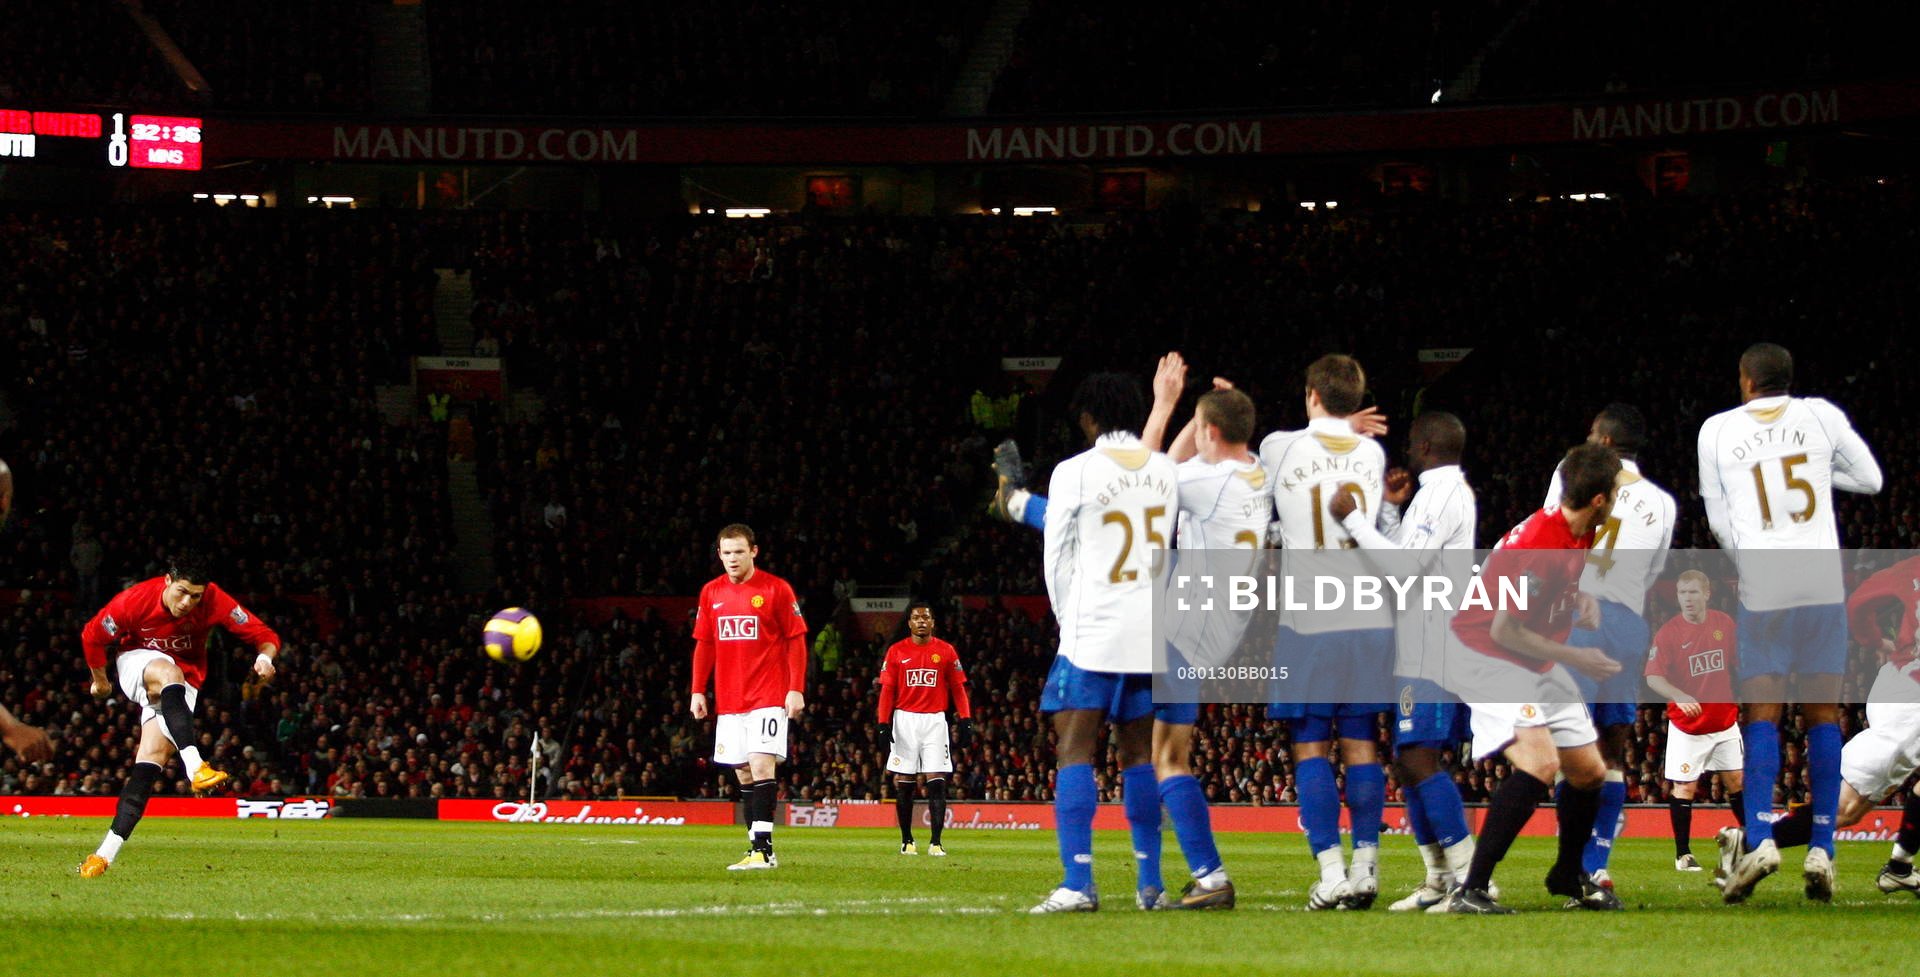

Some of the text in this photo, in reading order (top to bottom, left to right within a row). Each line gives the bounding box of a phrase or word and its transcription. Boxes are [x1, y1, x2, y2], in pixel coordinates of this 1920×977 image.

[1571, 88, 1840, 139] MANUTD.COM
[108, 141, 128, 167] 0
[332, 126, 638, 161] MANUTD.COM
[966, 121, 1262, 160] MANUTD.COM
[1732, 427, 1805, 460] DISTIN
[1750, 453, 1816, 530] 15
[1102, 505, 1166, 583] 25
[720, 618, 756, 637] AIG
[146, 636, 188, 649] AIG
[909, 670, 936, 685] AIG
[1693, 653, 1723, 673] AIG
[761, 717, 778, 737] 10
